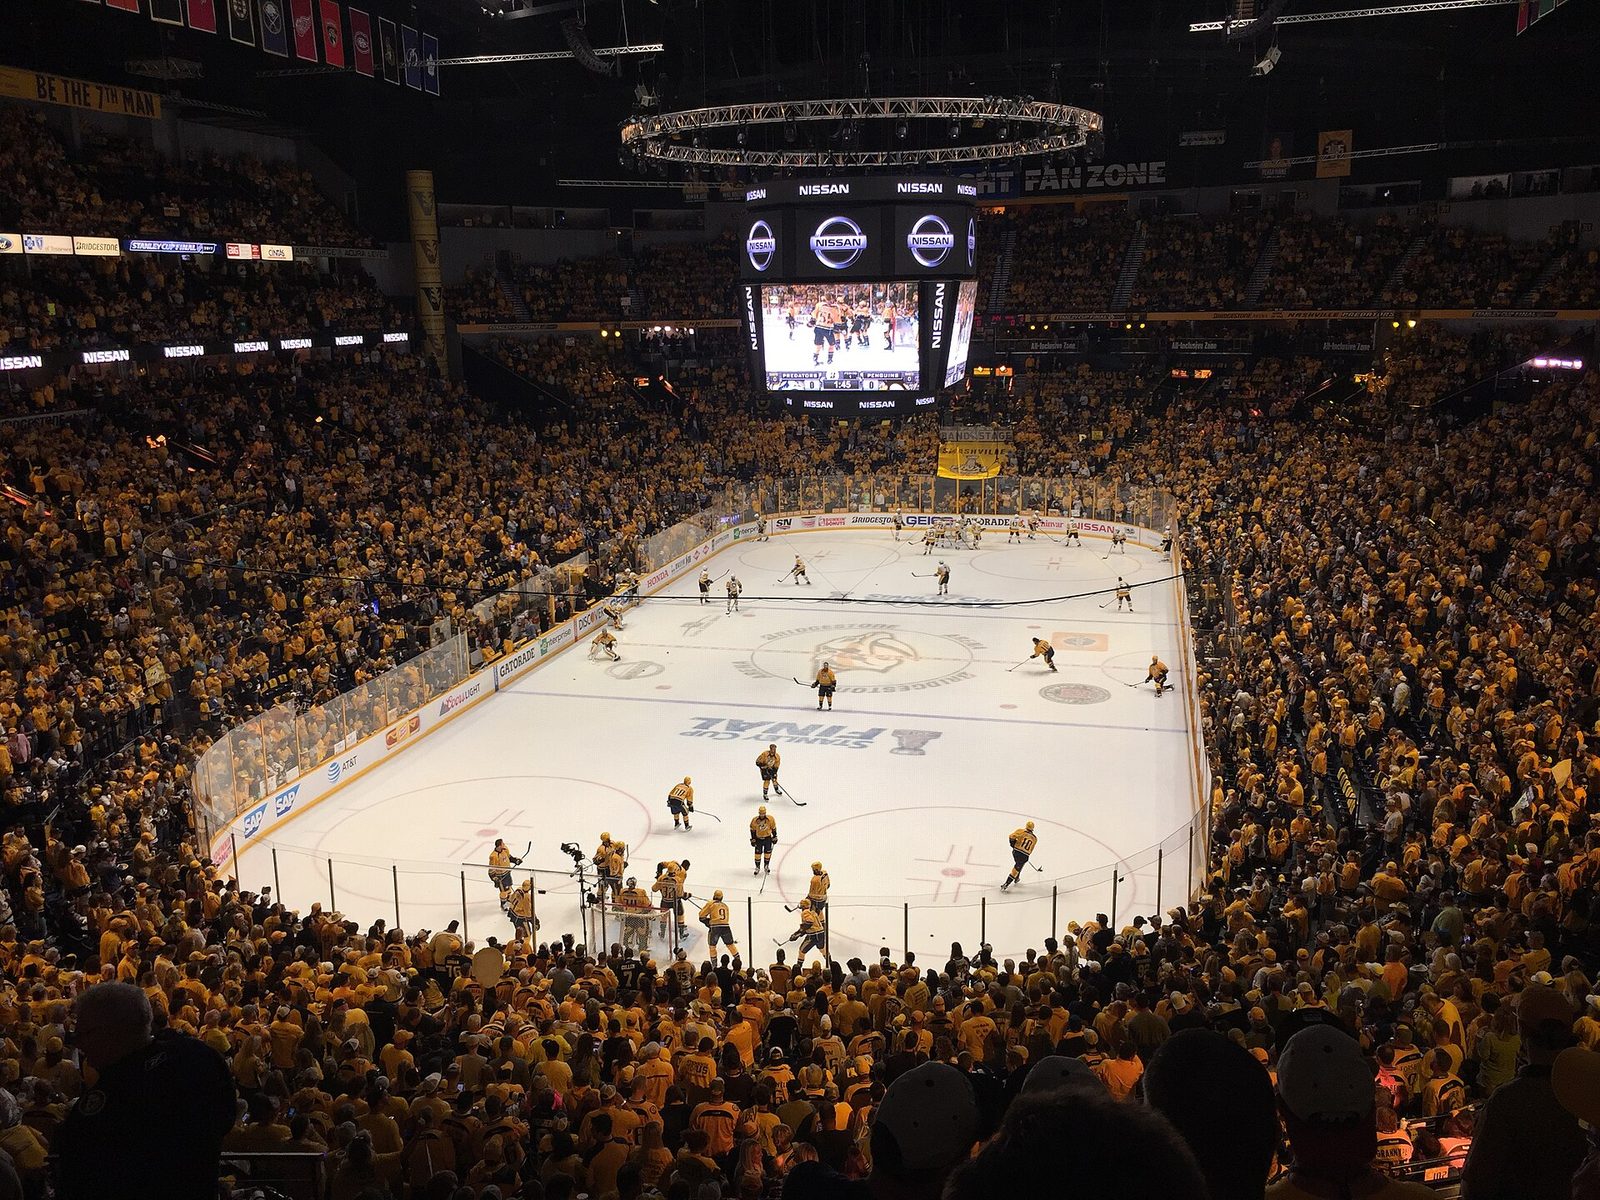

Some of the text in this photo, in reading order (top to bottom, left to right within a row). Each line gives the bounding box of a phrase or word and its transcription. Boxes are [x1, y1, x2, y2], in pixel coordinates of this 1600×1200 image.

[36, 74, 155, 117] BE THE 7TH MAN
[1025, 166, 1081, 192] FAN
[1086, 161, 1166, 188] ZONE
[799, 184, 850, 195] NISSAN
[897, 183, 943, 193] NISSAN
[76, 241, 119, 252] BRIDGESTONE
[132, 242, 161, 250] STANLEY
[749, 241, 774, 250] NISSAN
[815, 238, 862, 246] NISSAN
[911, 237, 950, 245] NISSAN
[745, 287, 759, 350] NISSAN
[931, 283, 945, 349] NISSAN
[280, 338, 312, 350] NISSAN
[335, 335, 363, 346] NISSAN
[383, 332, 409, 343] NISSAN
[164, 345, 205, 358] NISSAN
[233, 341, 269, 353] NISSAN
[83, 349, 130, 364] NISSAN
[833, 381, 852, 389] 1:45
[803, 400, 834, 409] NISSAN
[859, 400, 896, 409] NISSAN
[776, 518, 792, 526] SN
[646, 569, 670, 589] HONDA
[499, 647, 536, 678] GATORADE
[465, 683, 480, 699] LIGHT
[689, 716, 887, 741] FINAL
[679, 729, 875, 750] STANLEY CUP
[342, 755, 358, 772] AT&T
[275, 791, 296, 813] SAP
[244, 811, 263, 836] SAP
[718, 908, 726, 921] 9
[623, 970, 633, 988] 7
